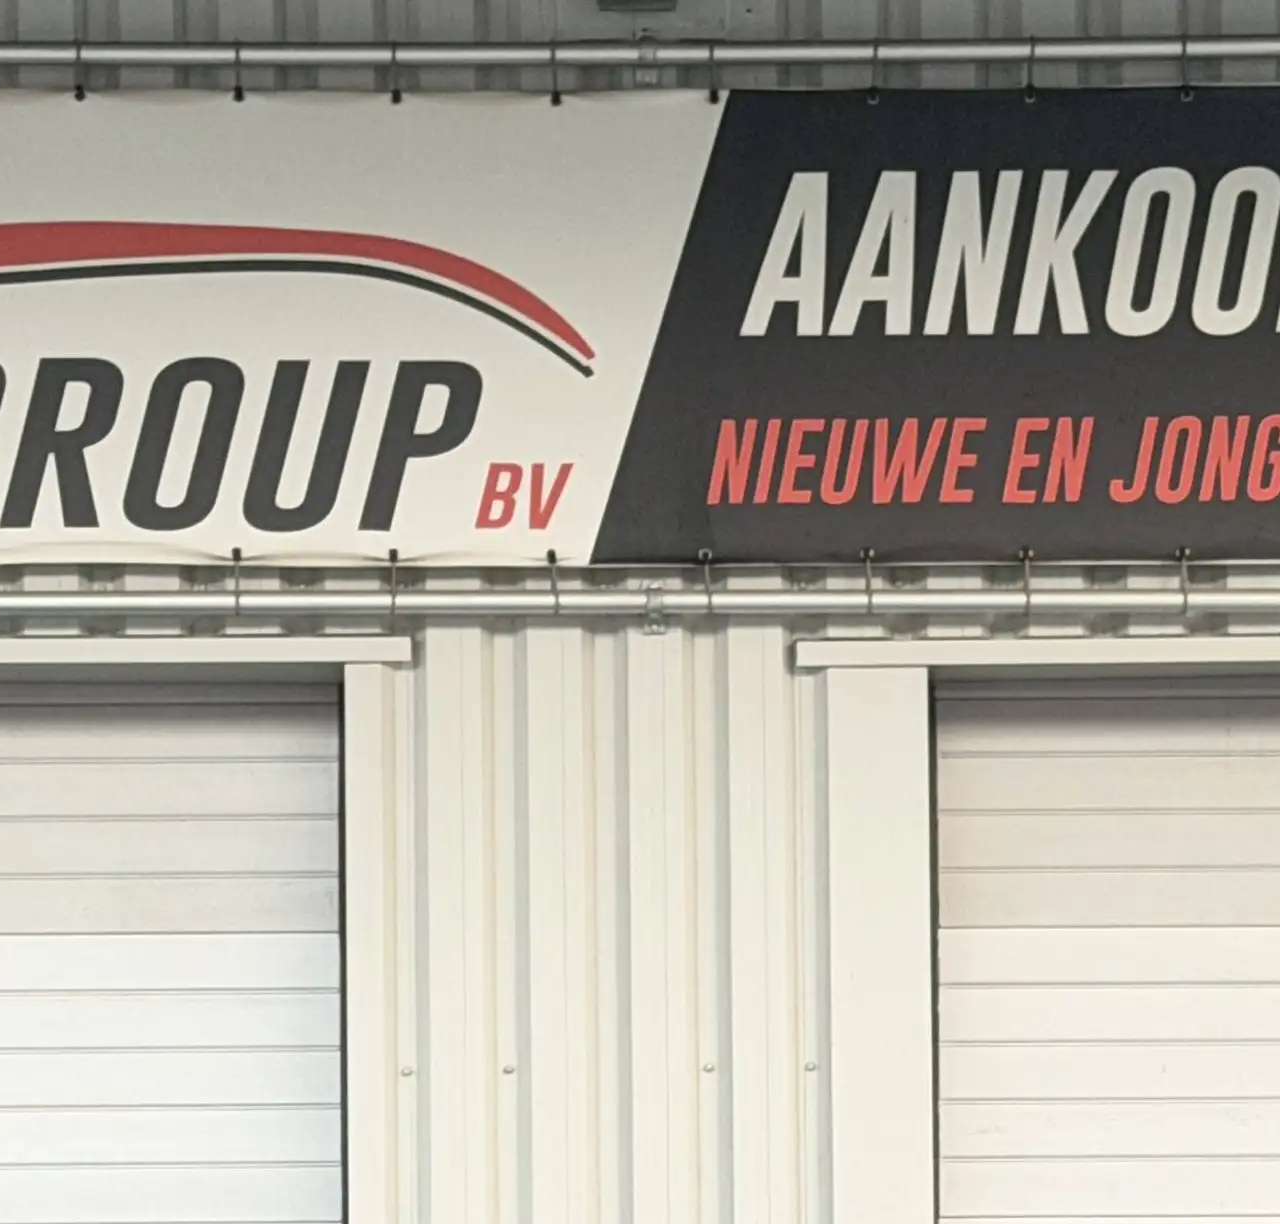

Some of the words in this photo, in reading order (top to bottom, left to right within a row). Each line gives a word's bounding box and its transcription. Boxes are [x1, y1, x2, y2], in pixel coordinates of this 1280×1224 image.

[475, 462, 574, 531] BV
[707, 416, 989, 507] NIEUWE
[1002, 415, 1096, 505] EN
